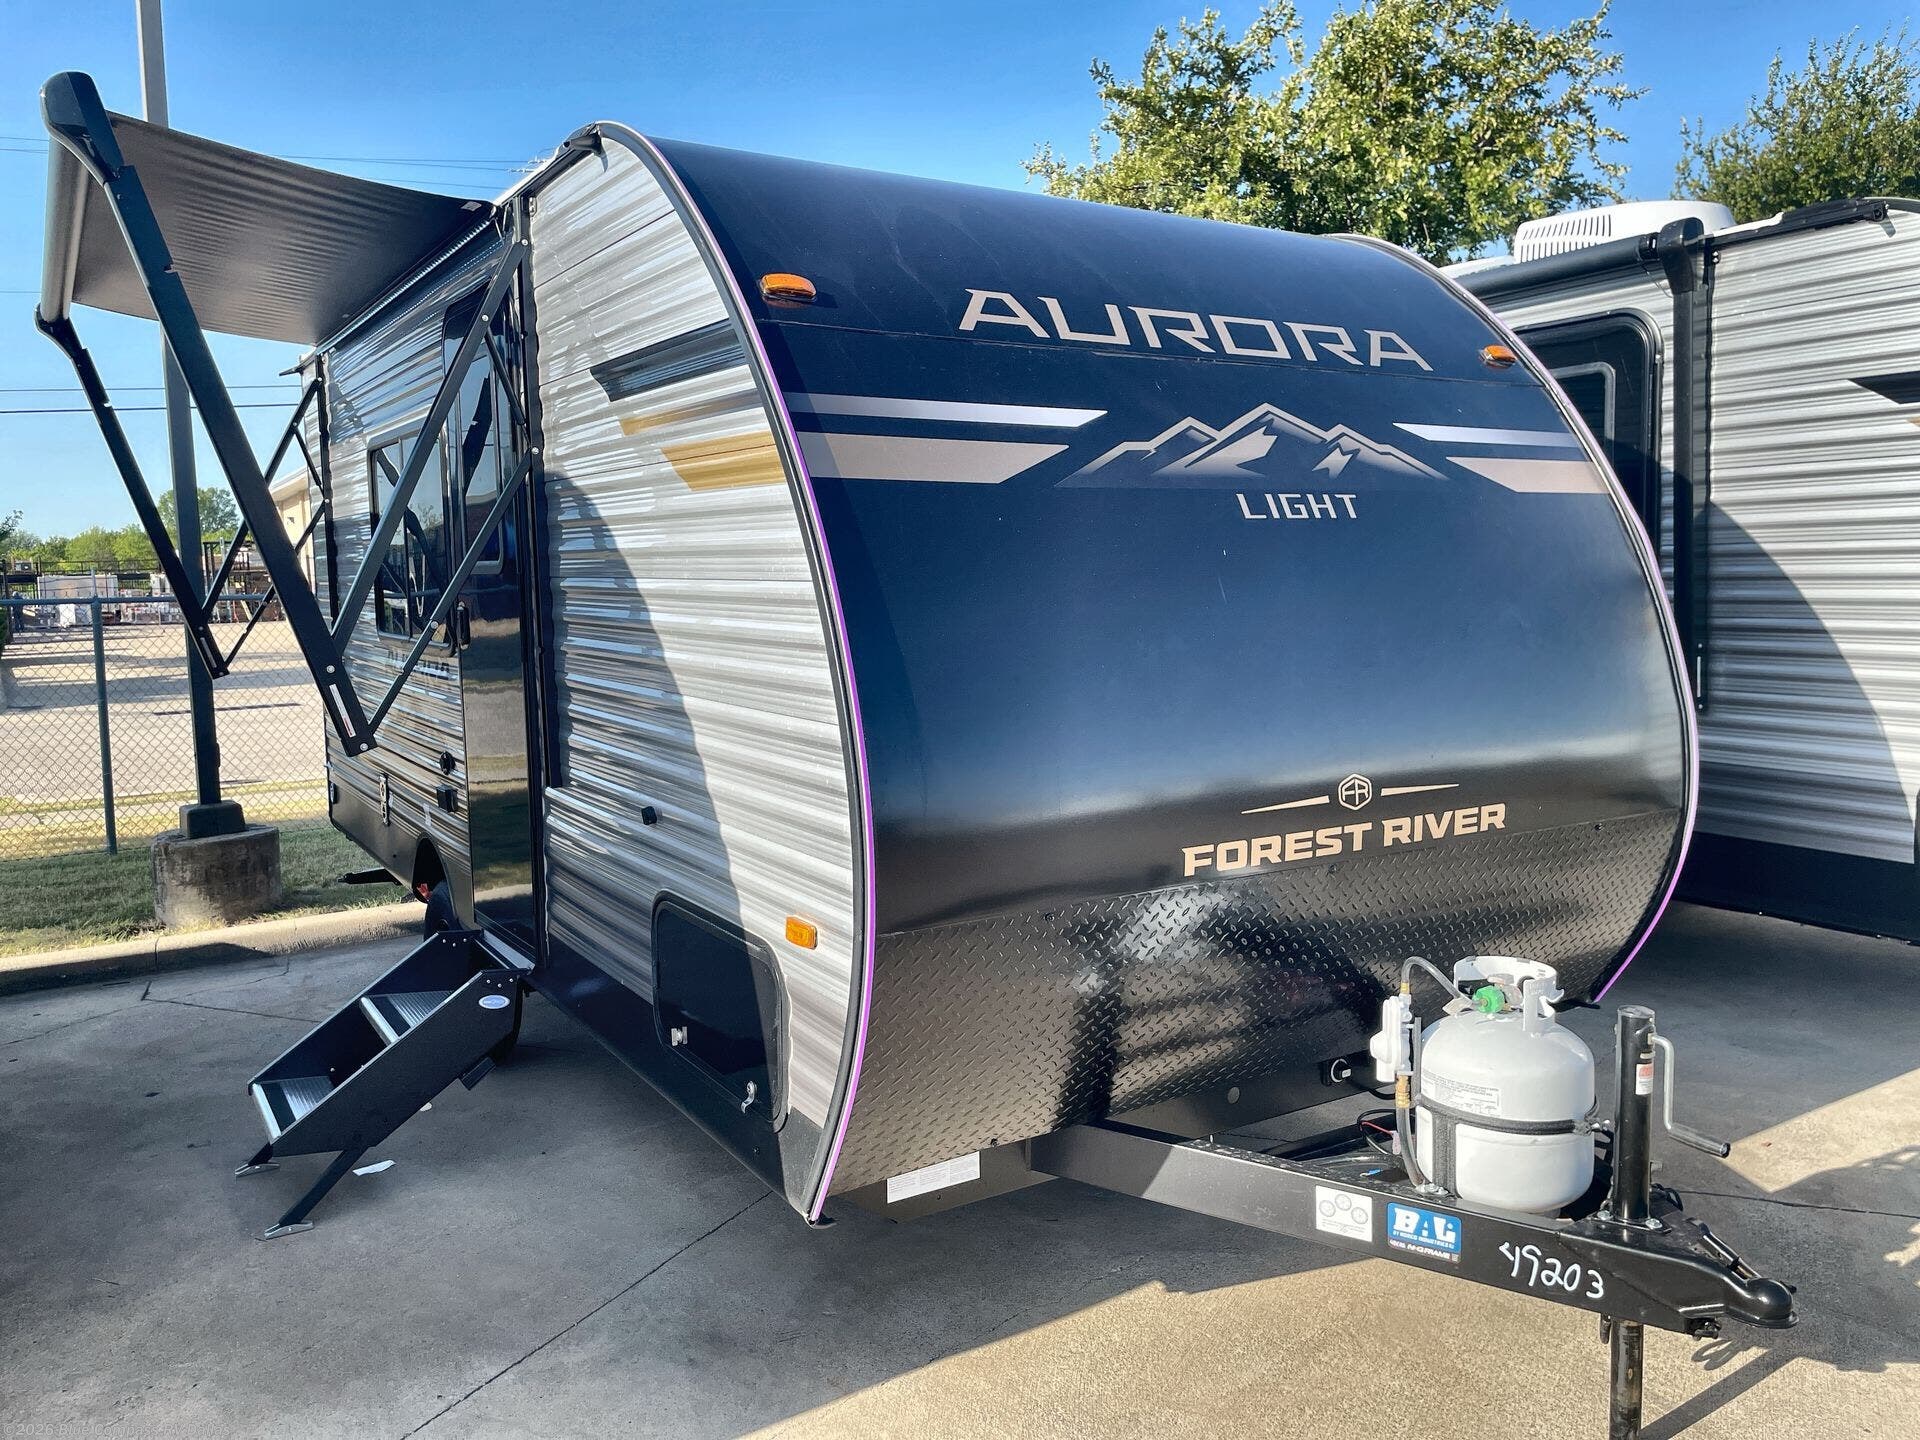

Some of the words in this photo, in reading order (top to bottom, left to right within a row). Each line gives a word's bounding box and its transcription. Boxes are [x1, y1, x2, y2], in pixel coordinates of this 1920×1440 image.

[959, 288, 1434, 372] AURORA
[1236, 493, 1357, 519] LIGHT
[1181, 822, 1373, 877] FOREST
[1381, 803, 1506, 847] RIVER
[1499, 1242, 1604, 1299] 49203
